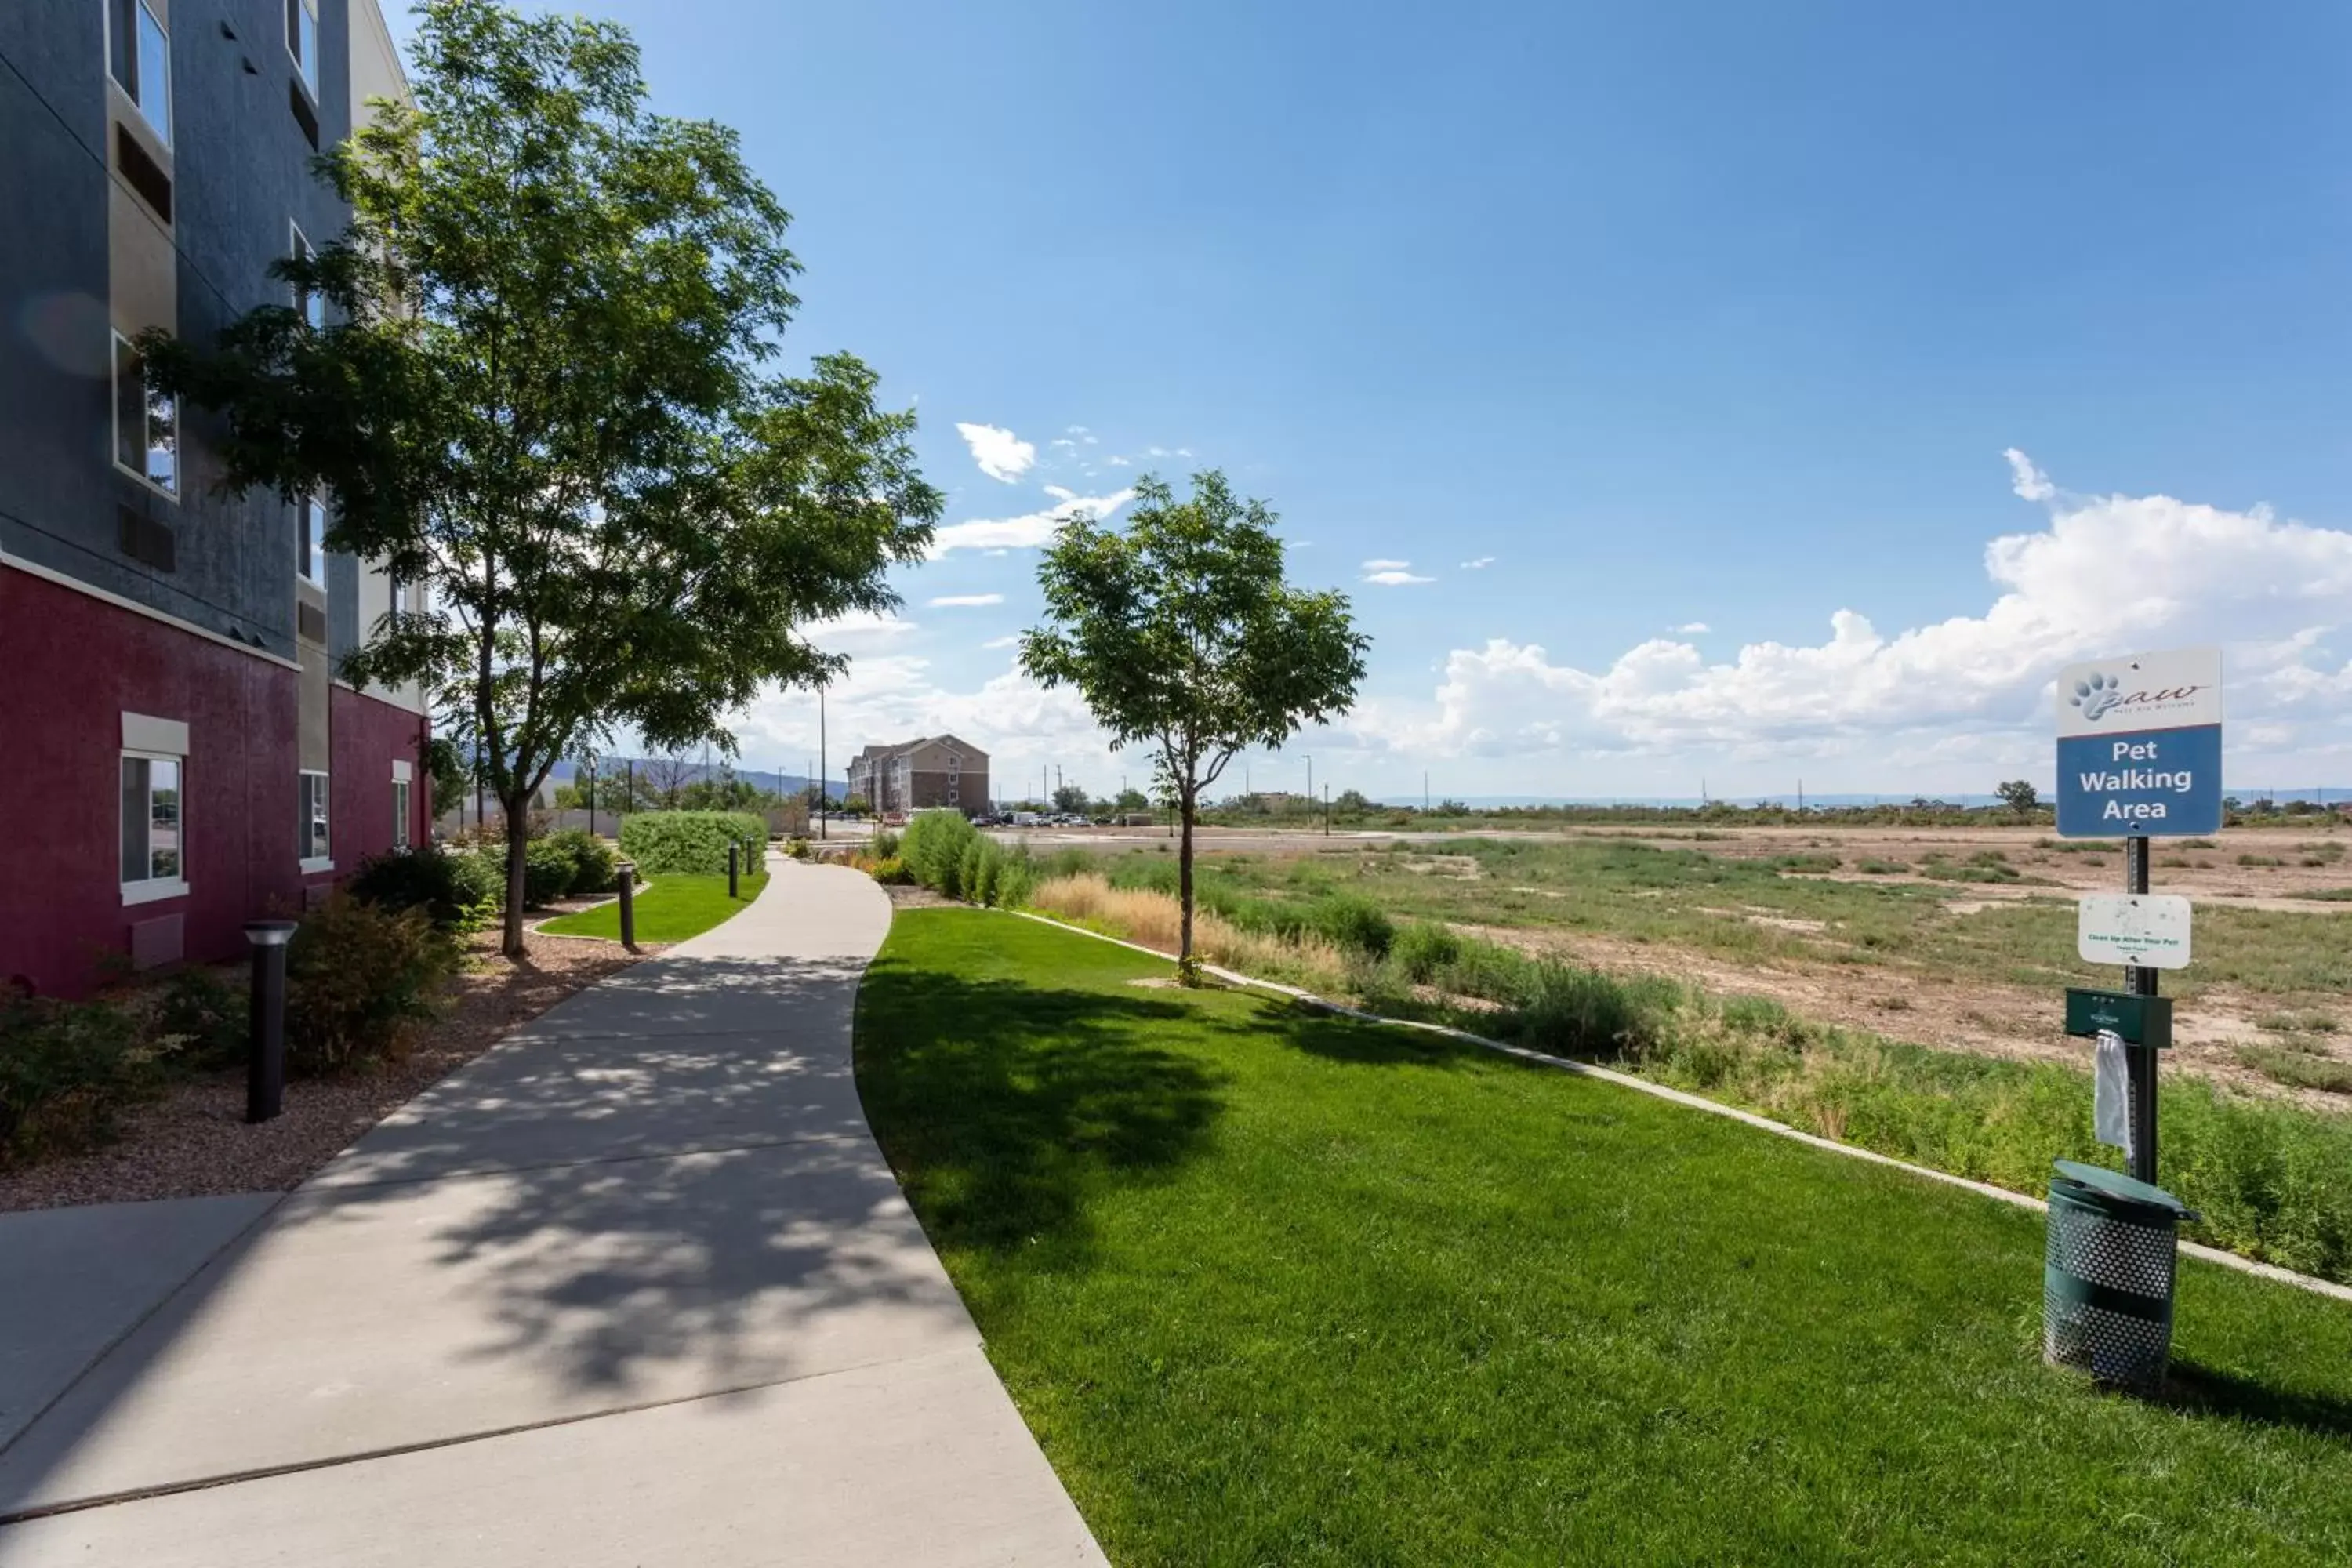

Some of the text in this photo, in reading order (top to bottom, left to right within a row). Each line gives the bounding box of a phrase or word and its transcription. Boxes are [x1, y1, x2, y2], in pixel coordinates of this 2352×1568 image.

[2112, 741, 2158, 761] Pet
[2080, 768, 2192, 793] Walking
[2103, 800, 2167, 820] Area
